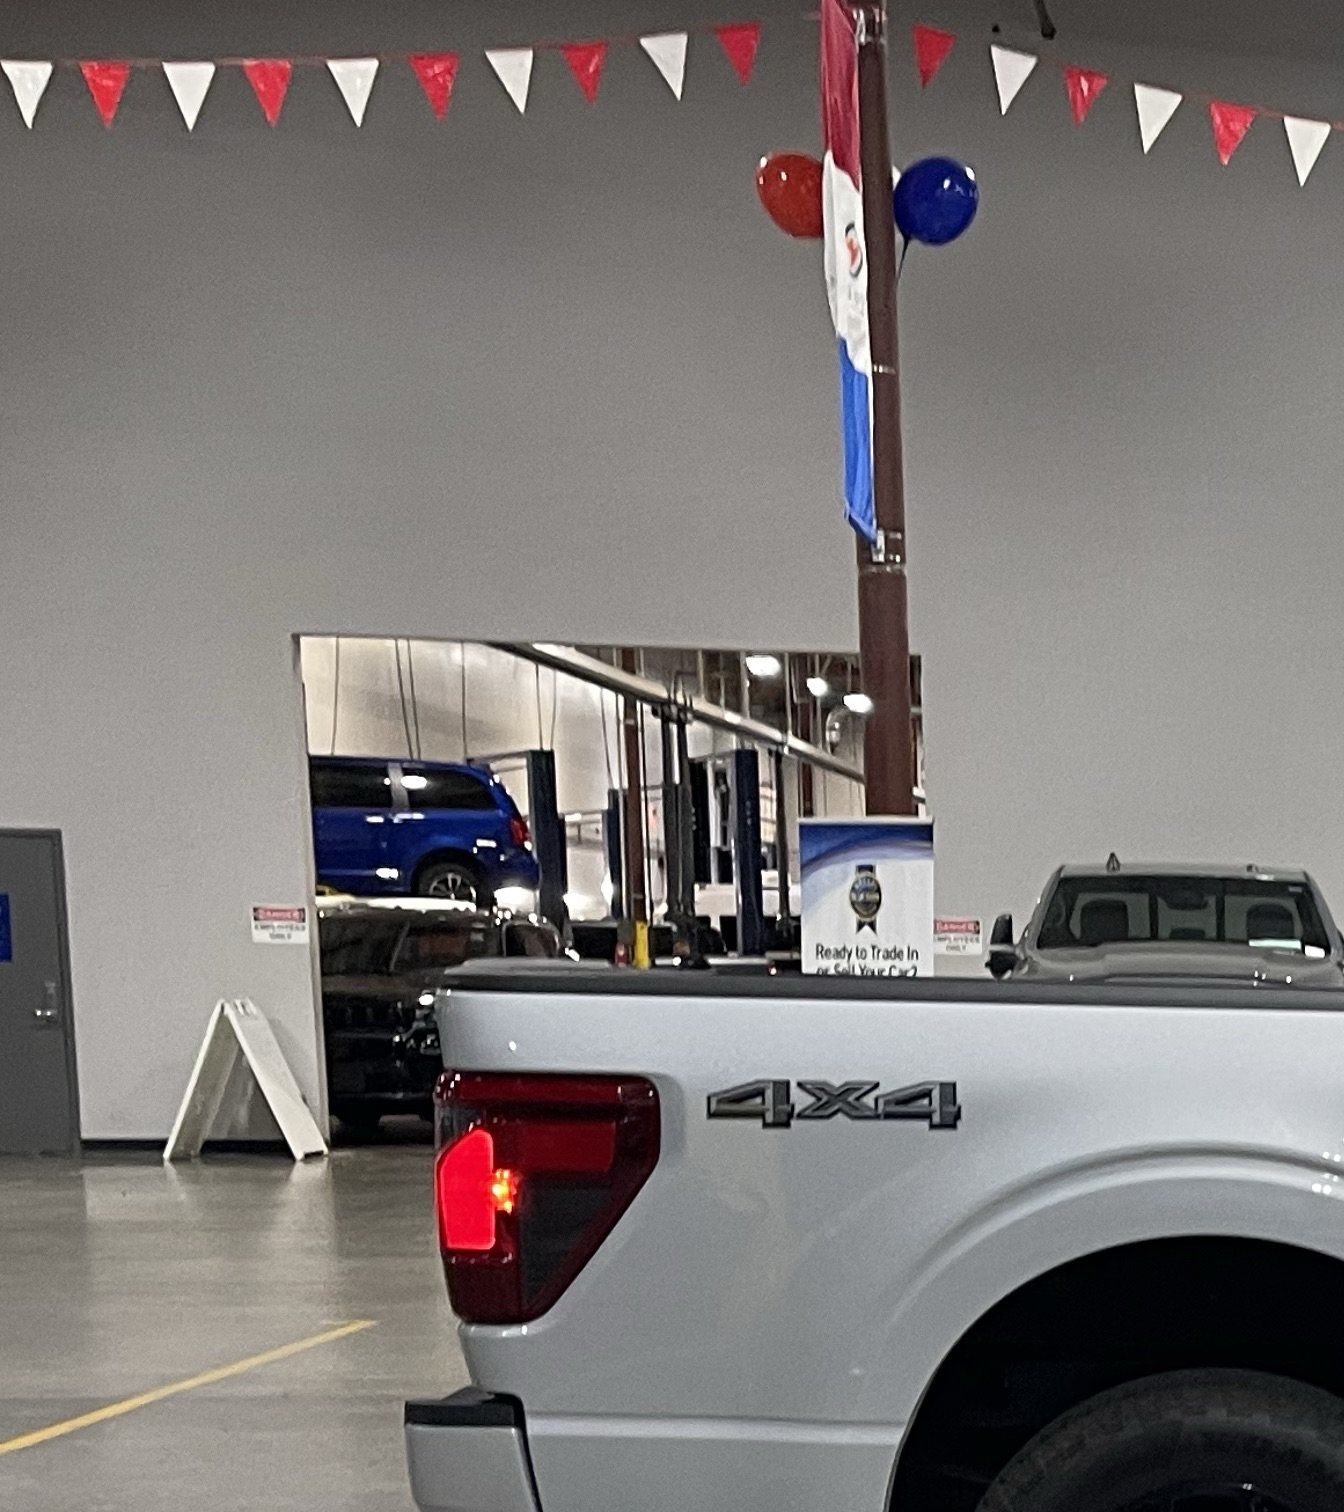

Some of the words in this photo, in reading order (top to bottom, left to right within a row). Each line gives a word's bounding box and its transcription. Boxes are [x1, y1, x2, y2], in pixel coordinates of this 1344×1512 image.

[815, 942, 853, 967] Ready
[855, 944, 867, 961] to
[871, 944, 904, 961] Trade
[907, 944, 919, 961] In
[834, 962, 856, 976] Sell
[859, 963, 886, 976] Your
